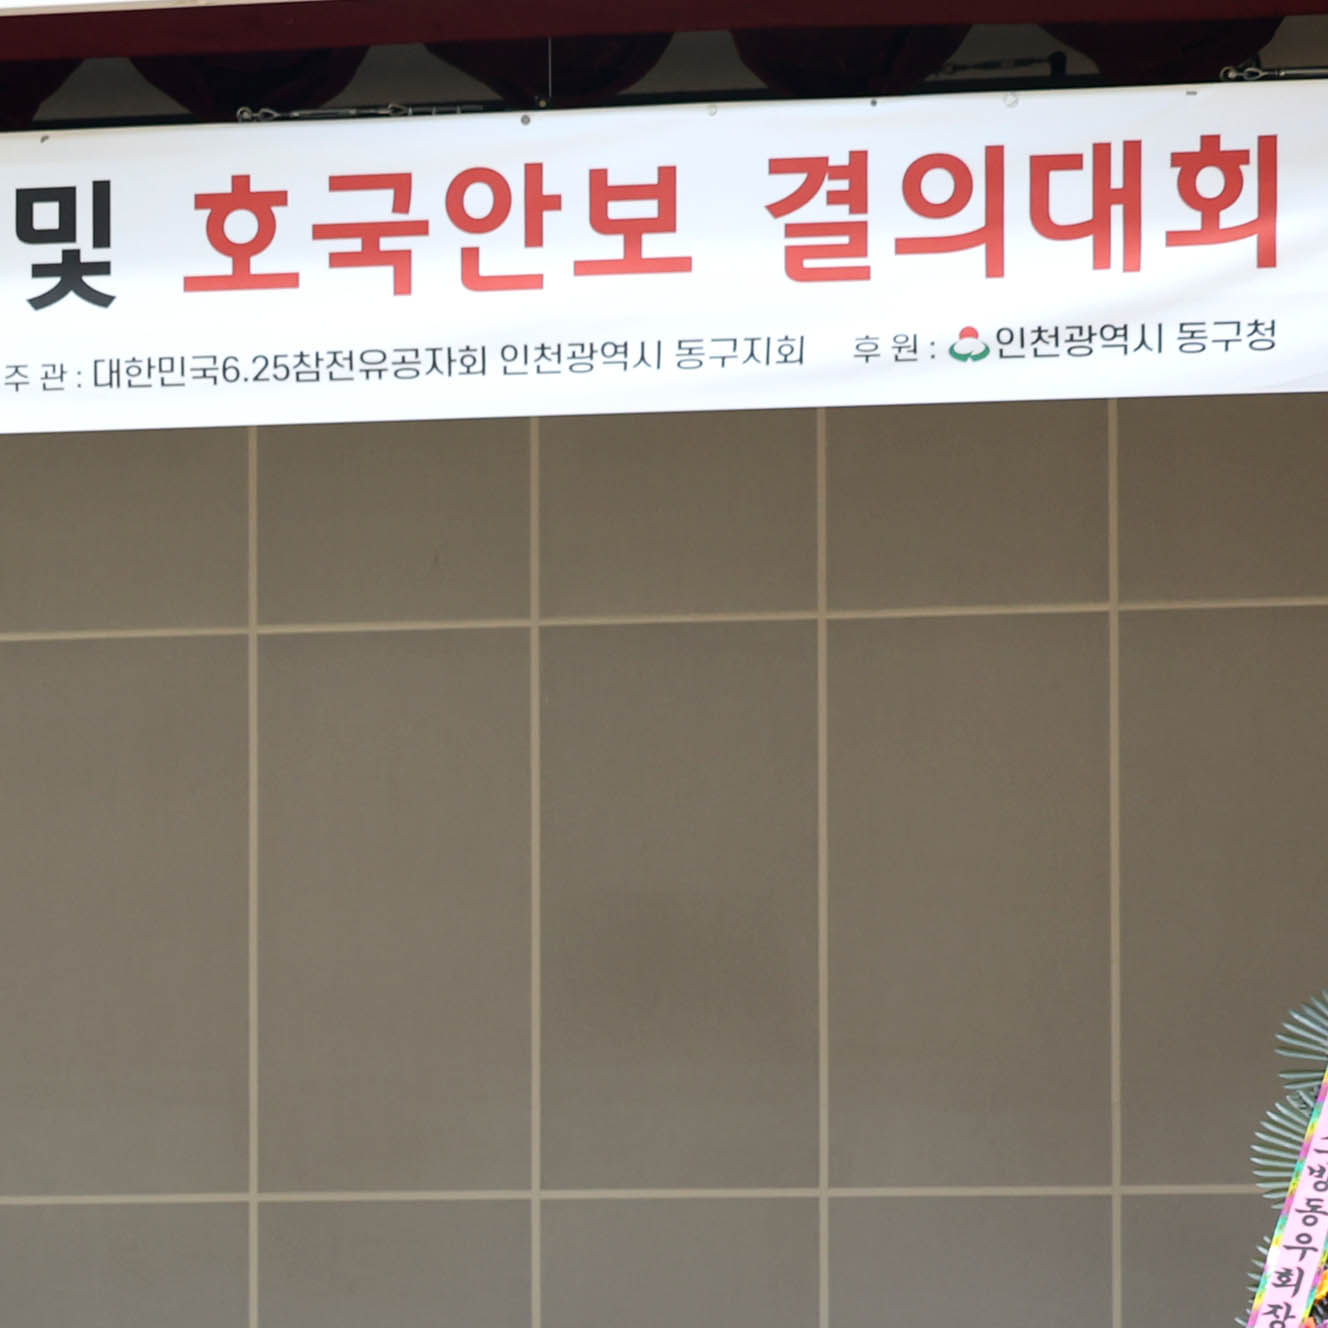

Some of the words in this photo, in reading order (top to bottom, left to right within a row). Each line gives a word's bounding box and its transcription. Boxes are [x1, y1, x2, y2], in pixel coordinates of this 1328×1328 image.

[15, 180, 116, 311] 및
[183, 162, 692, 297] 호국안보
[764, 133, 1278, 283] 결의대회
[93, 344, 487, 390] 대한민국6.25참전유공자회
[500, 339, 662, 376] 인천광역시
[675, 334, 805, 369] 동구지회
[996, 323, 1163, 360] 인천광역시
[1176, 318, 1276, 354] 동구청
